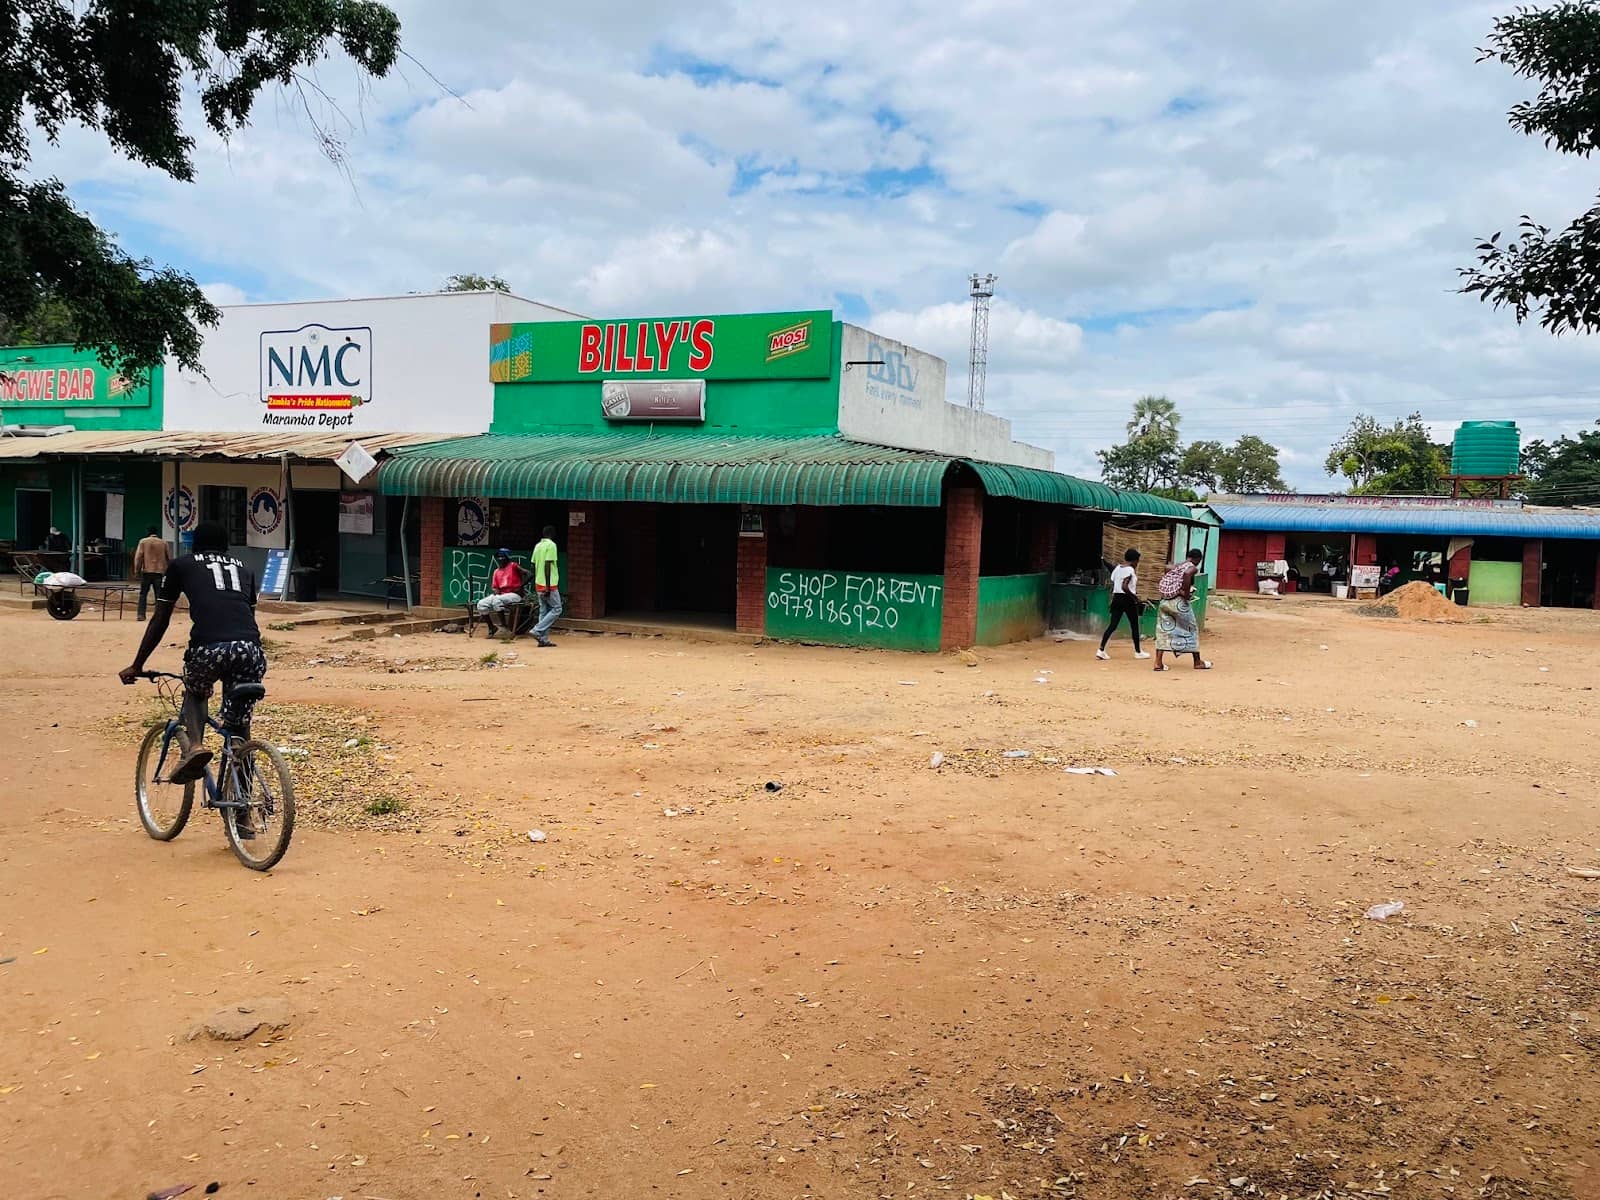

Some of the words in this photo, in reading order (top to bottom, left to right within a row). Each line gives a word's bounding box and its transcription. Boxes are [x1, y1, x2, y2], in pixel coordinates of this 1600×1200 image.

[578, 319, 715, 373] BILLY'S
[770, 326, 808, 351] MOSI
[268, 342, 361, 387] NMC
[56, 367, 95, 400] BAR
[268, 396, 296, 406] Zambia's
[297, 397, 315, 406] Pride
[315, 397, 351, 407] Nationwide
[262, 412, 316, 426] Maramba
[318, 411, 354, 430] Depot
[206, 562, 242, 592] 11
[779, 573, 838, 598] SHOP
[768, 592, 899, 632] 0978186920
